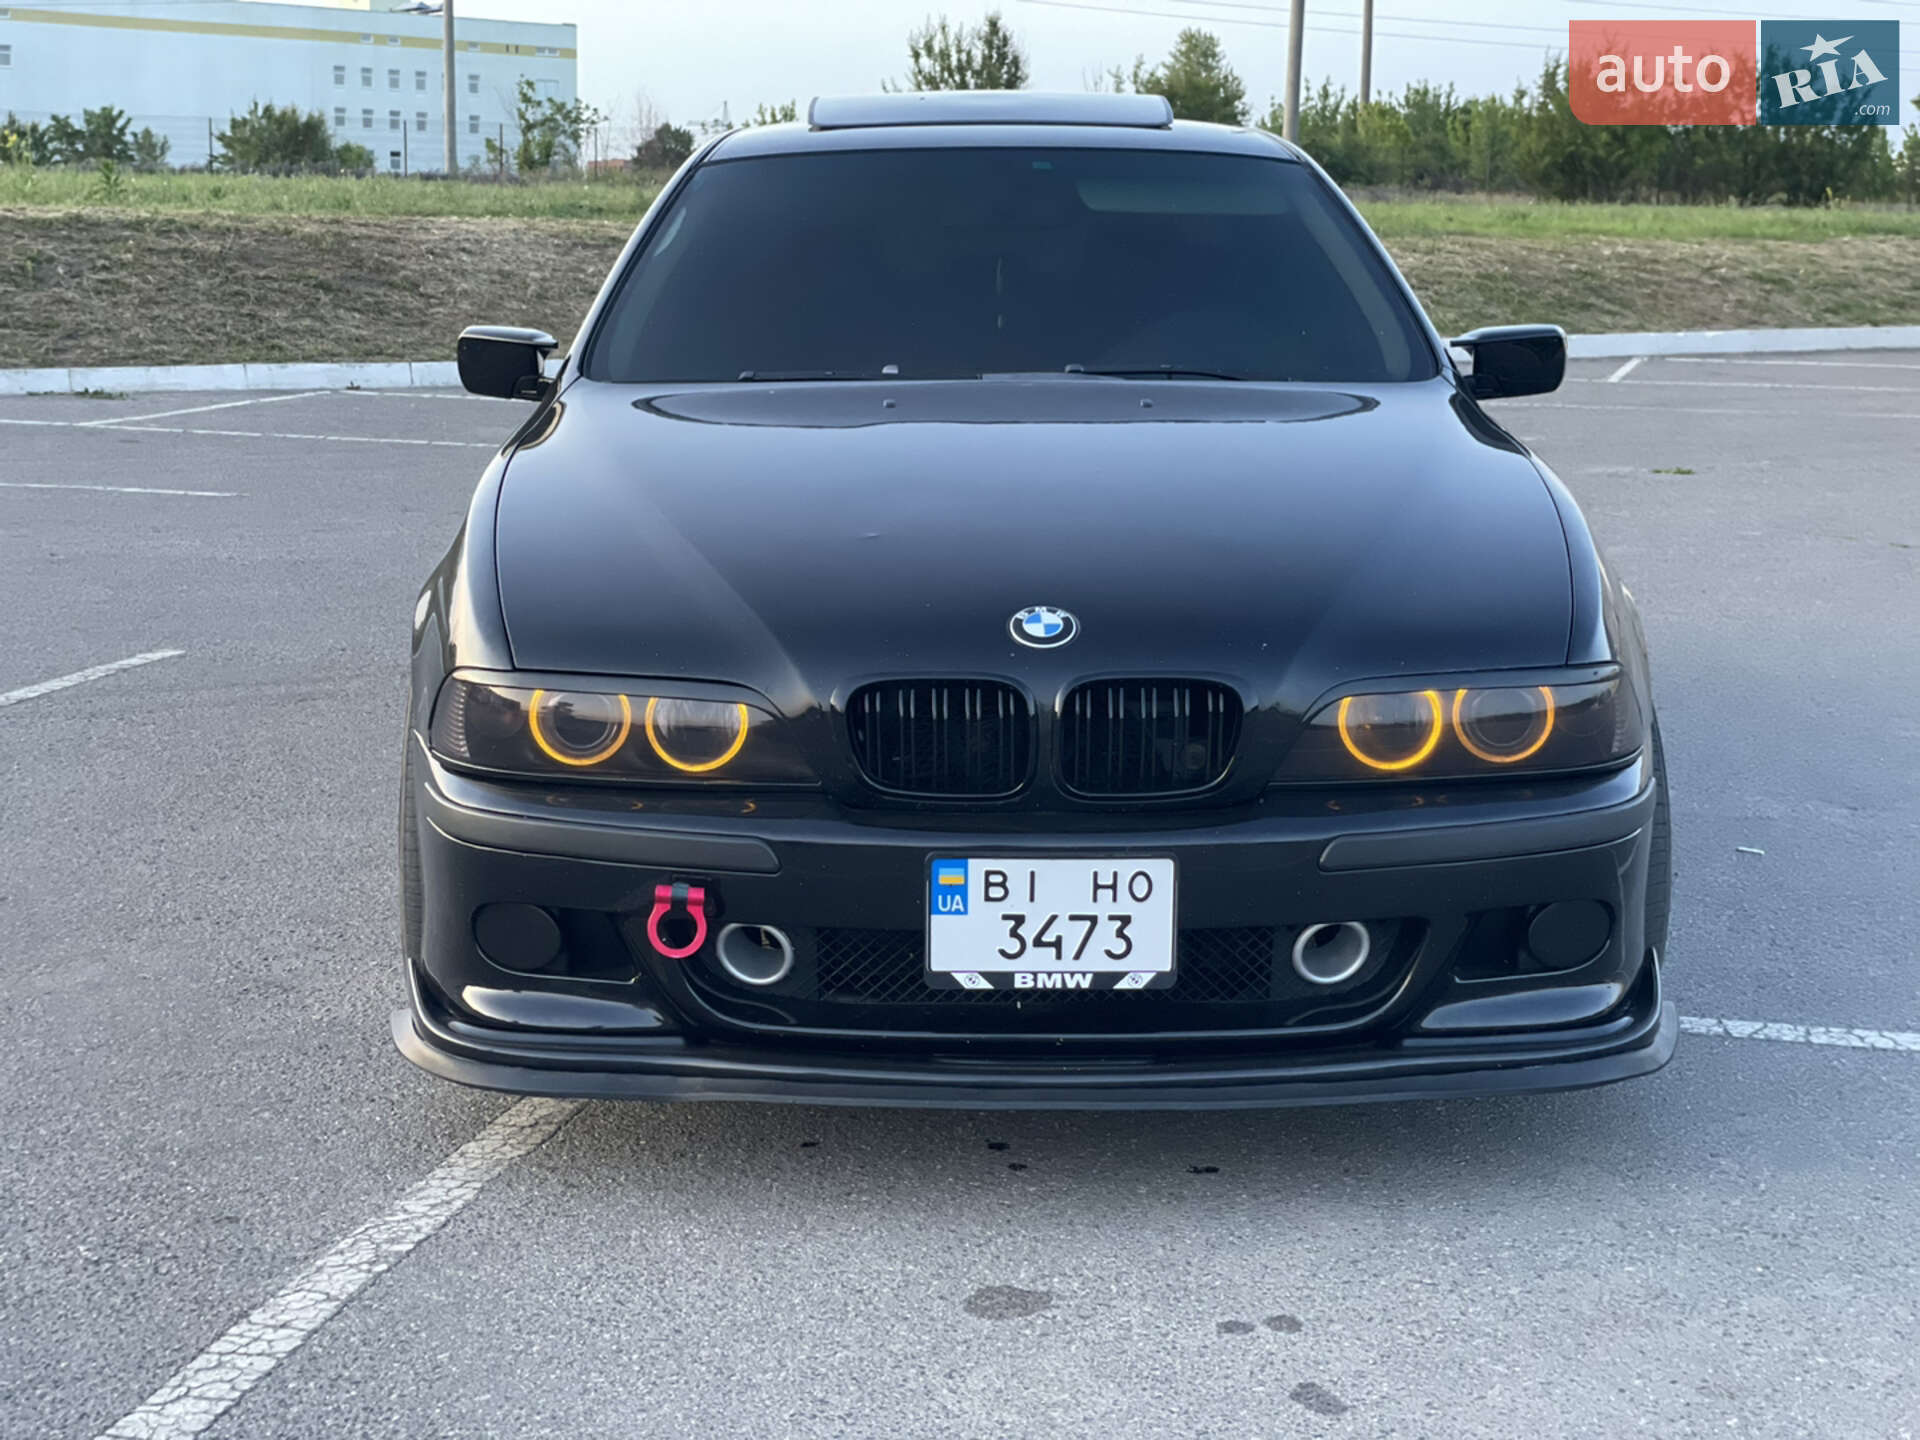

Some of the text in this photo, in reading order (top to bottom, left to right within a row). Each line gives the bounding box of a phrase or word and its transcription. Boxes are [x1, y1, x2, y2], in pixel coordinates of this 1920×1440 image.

[983, 869, 1153, 903] BI HO
[937, 894, 965, 912] UA
[997, 913, 1133, 961] 3473
[1013, 972, 1094, 989] BMW
